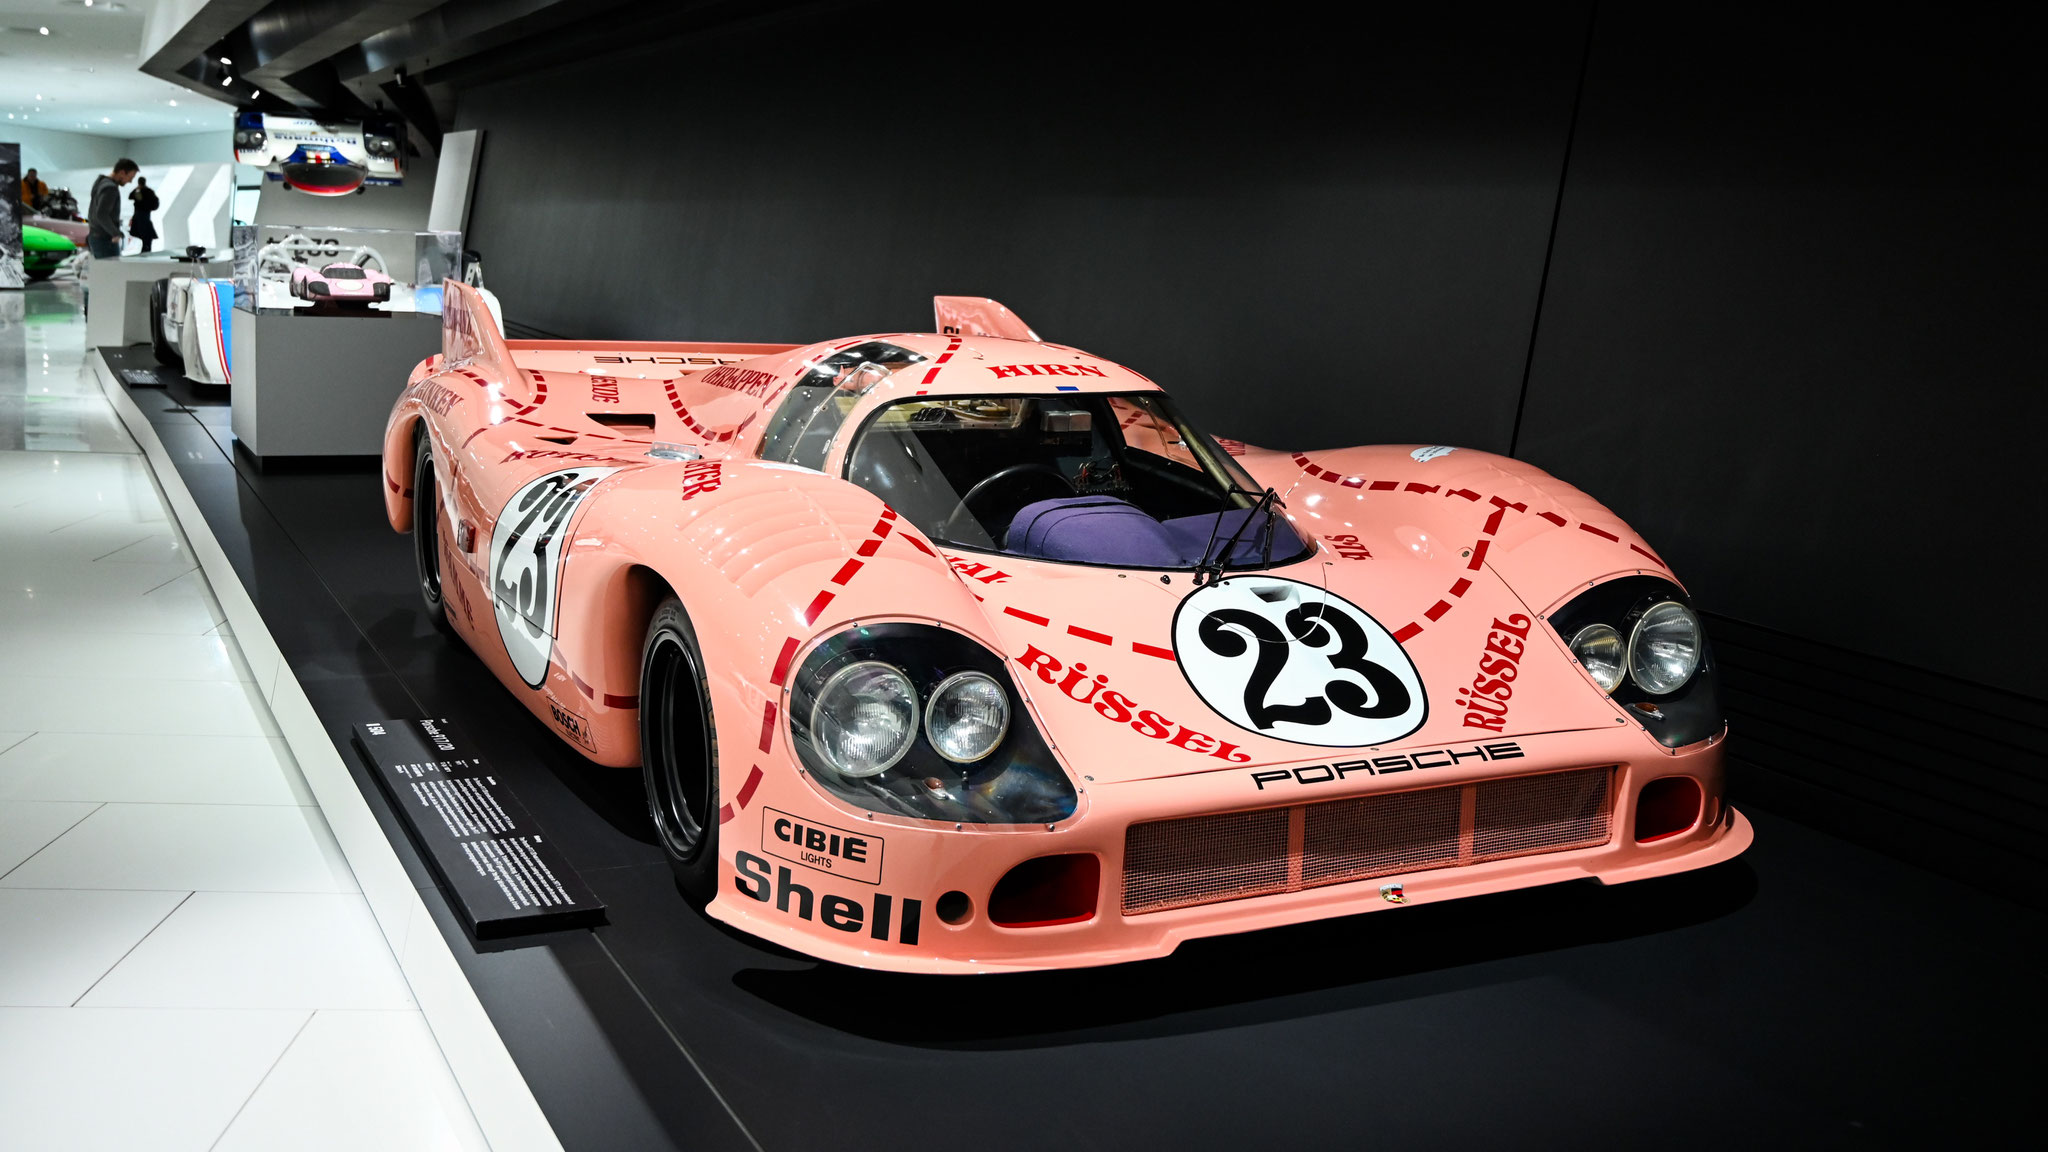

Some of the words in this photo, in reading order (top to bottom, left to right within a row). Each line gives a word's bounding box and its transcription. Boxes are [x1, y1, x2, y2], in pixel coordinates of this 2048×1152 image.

[986, 363, 1110, 378] HIRN
[495, 472, 600, 640] 23
[1014, 643, 1252, 763] RÜSSEL
[1198, 602, 1412, 731] 23
[1455, 612, 1532, 733] RÜSSEL
[550, 704, 582, 737] BOSCH
[1250, 742, 1525, 791] PORSCHE
[735, 850, 922, 946] Shell
[800, 850, 833, 869] LIGHTS
